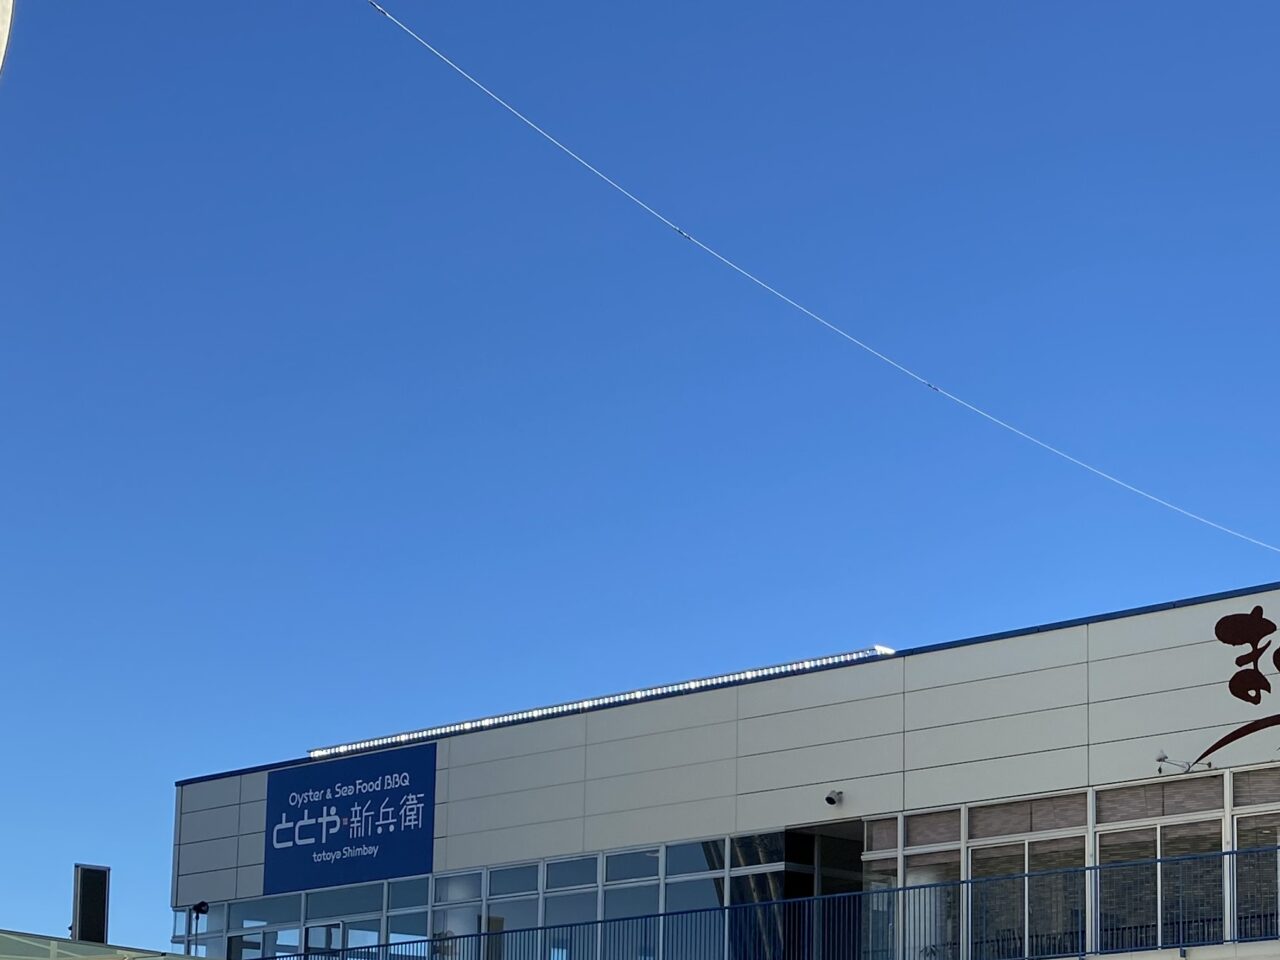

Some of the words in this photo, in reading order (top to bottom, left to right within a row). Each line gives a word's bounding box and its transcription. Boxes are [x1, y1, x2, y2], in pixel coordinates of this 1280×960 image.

[288, 789, 325, 808] Oyster
[325, 788, 333, 800] &
[334, 784, 355, 798] Sea
[355, 777, 381, 795] Food
[383, 772, 410, 790] BBQ
[272, 805, 341, 849] ととや
[349, 793, 425, 840] 新兵衛
[312, 850, 342, 864] totoya
[342, 844, 379, 859] Shimbay
